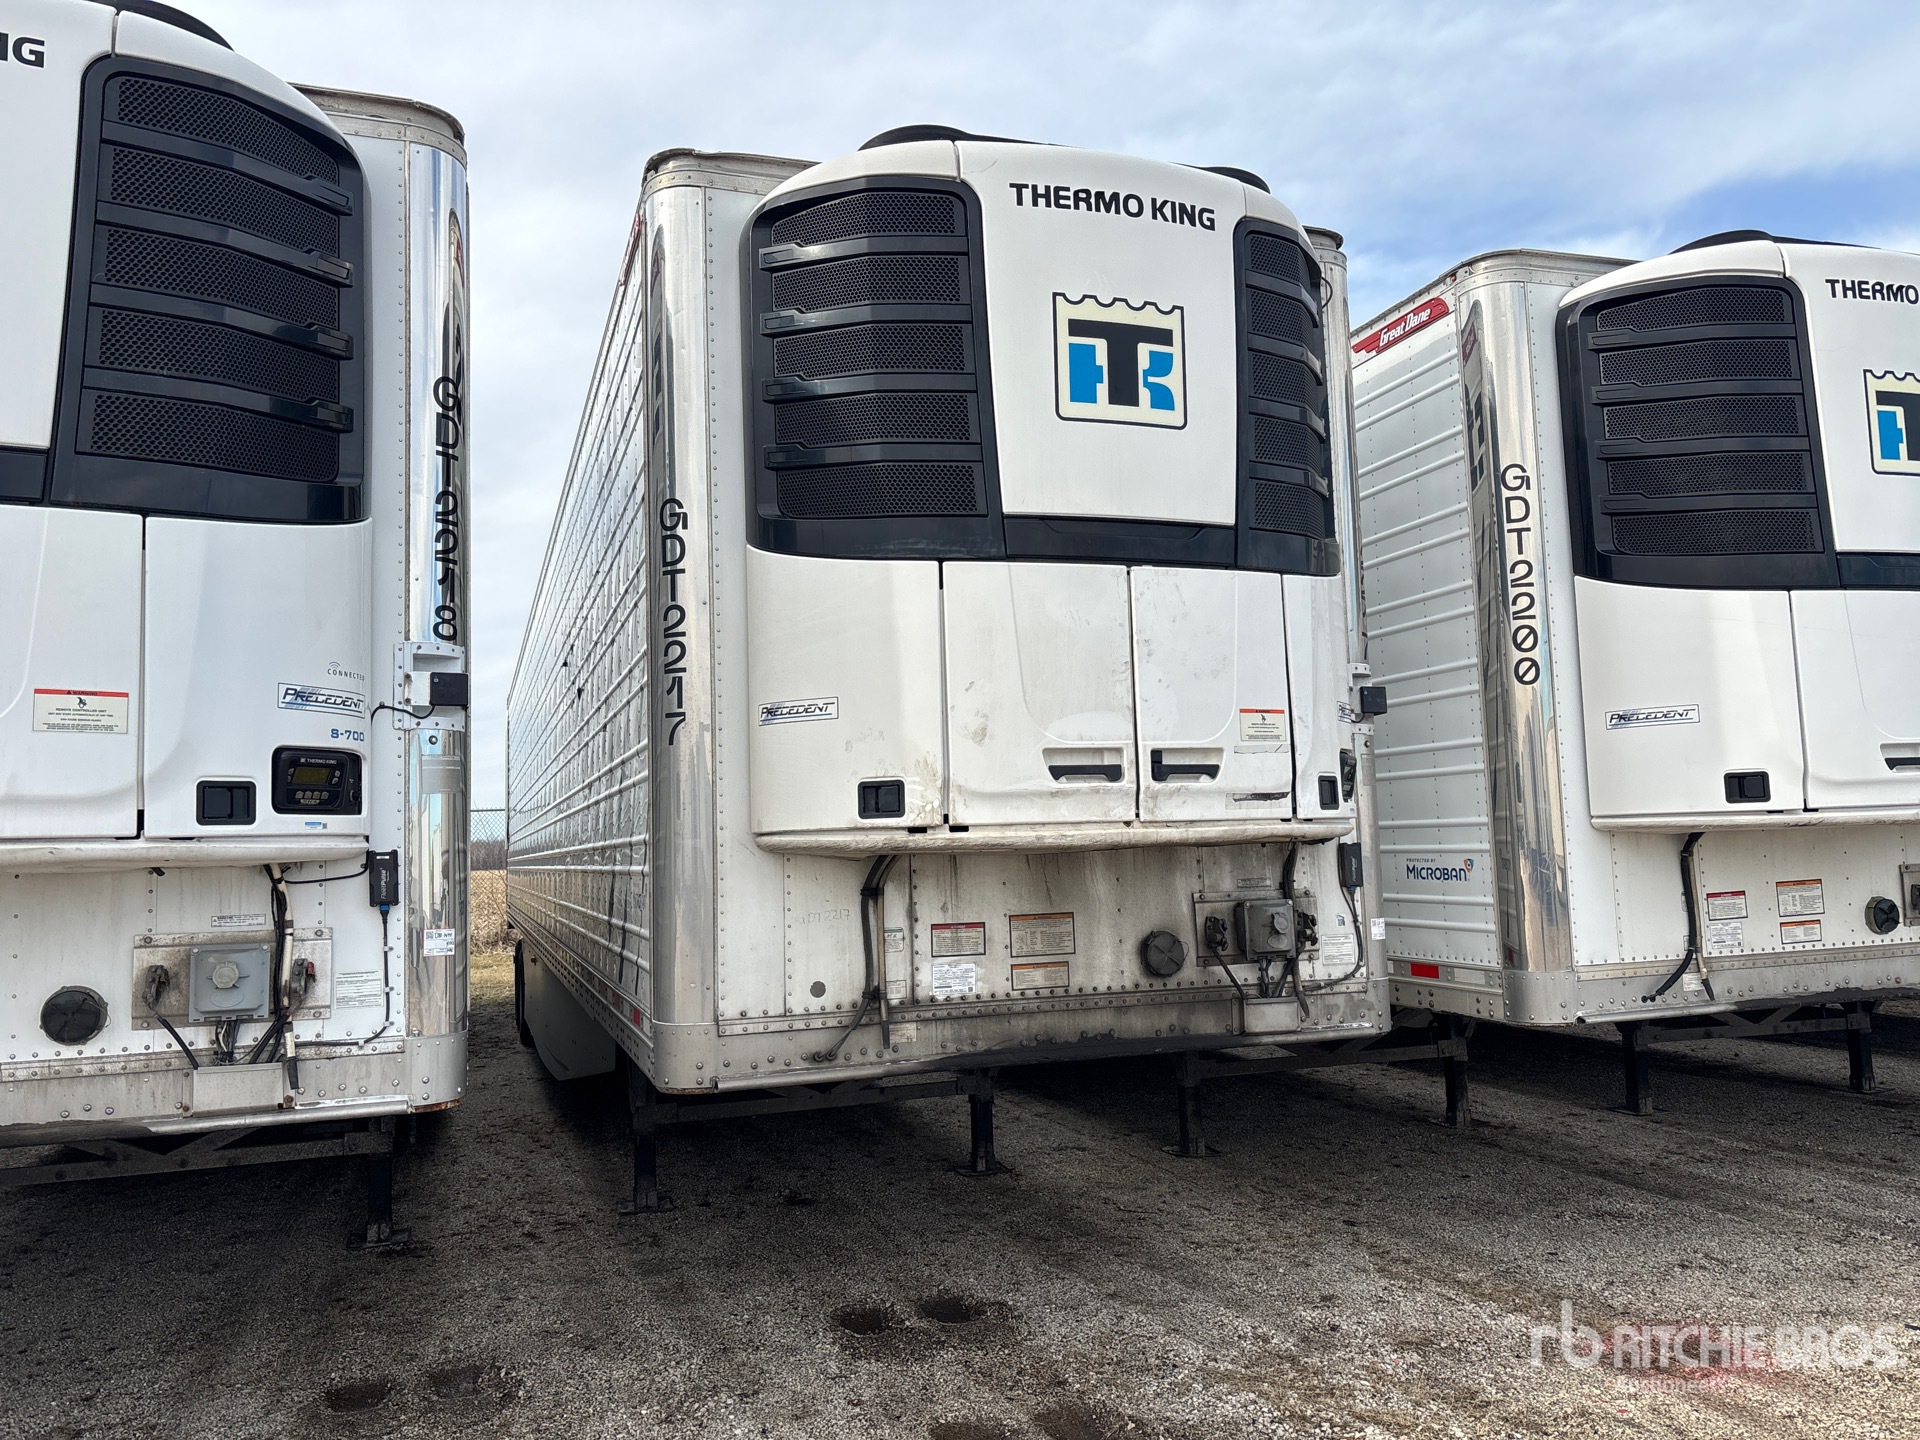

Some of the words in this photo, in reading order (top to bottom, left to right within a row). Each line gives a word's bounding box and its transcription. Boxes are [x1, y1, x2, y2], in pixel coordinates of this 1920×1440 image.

[1009, 183, 1144, 218] THERMO
[1151, 198, 1216, 231] KING
[1825, 279, 1919, 304] THERMO
[1380, 321, 1406, 347] Great
[1405, 308, 1431, 332] Dane
[1501, 464, 1541, 685] GDT2200
[660, 498, 688, 746] GDT2217
[327, 668, 365, 681] CONNECTED
[282, 687, 364, 710] PRECEDENT
[760, 702, 836, 718] PRECEDENT
[1609, 708, 1696, 724] PRECEDENT
[330, 728, 365, 741] S-700
[1406, 864, 1467, 881] MICROBAN
